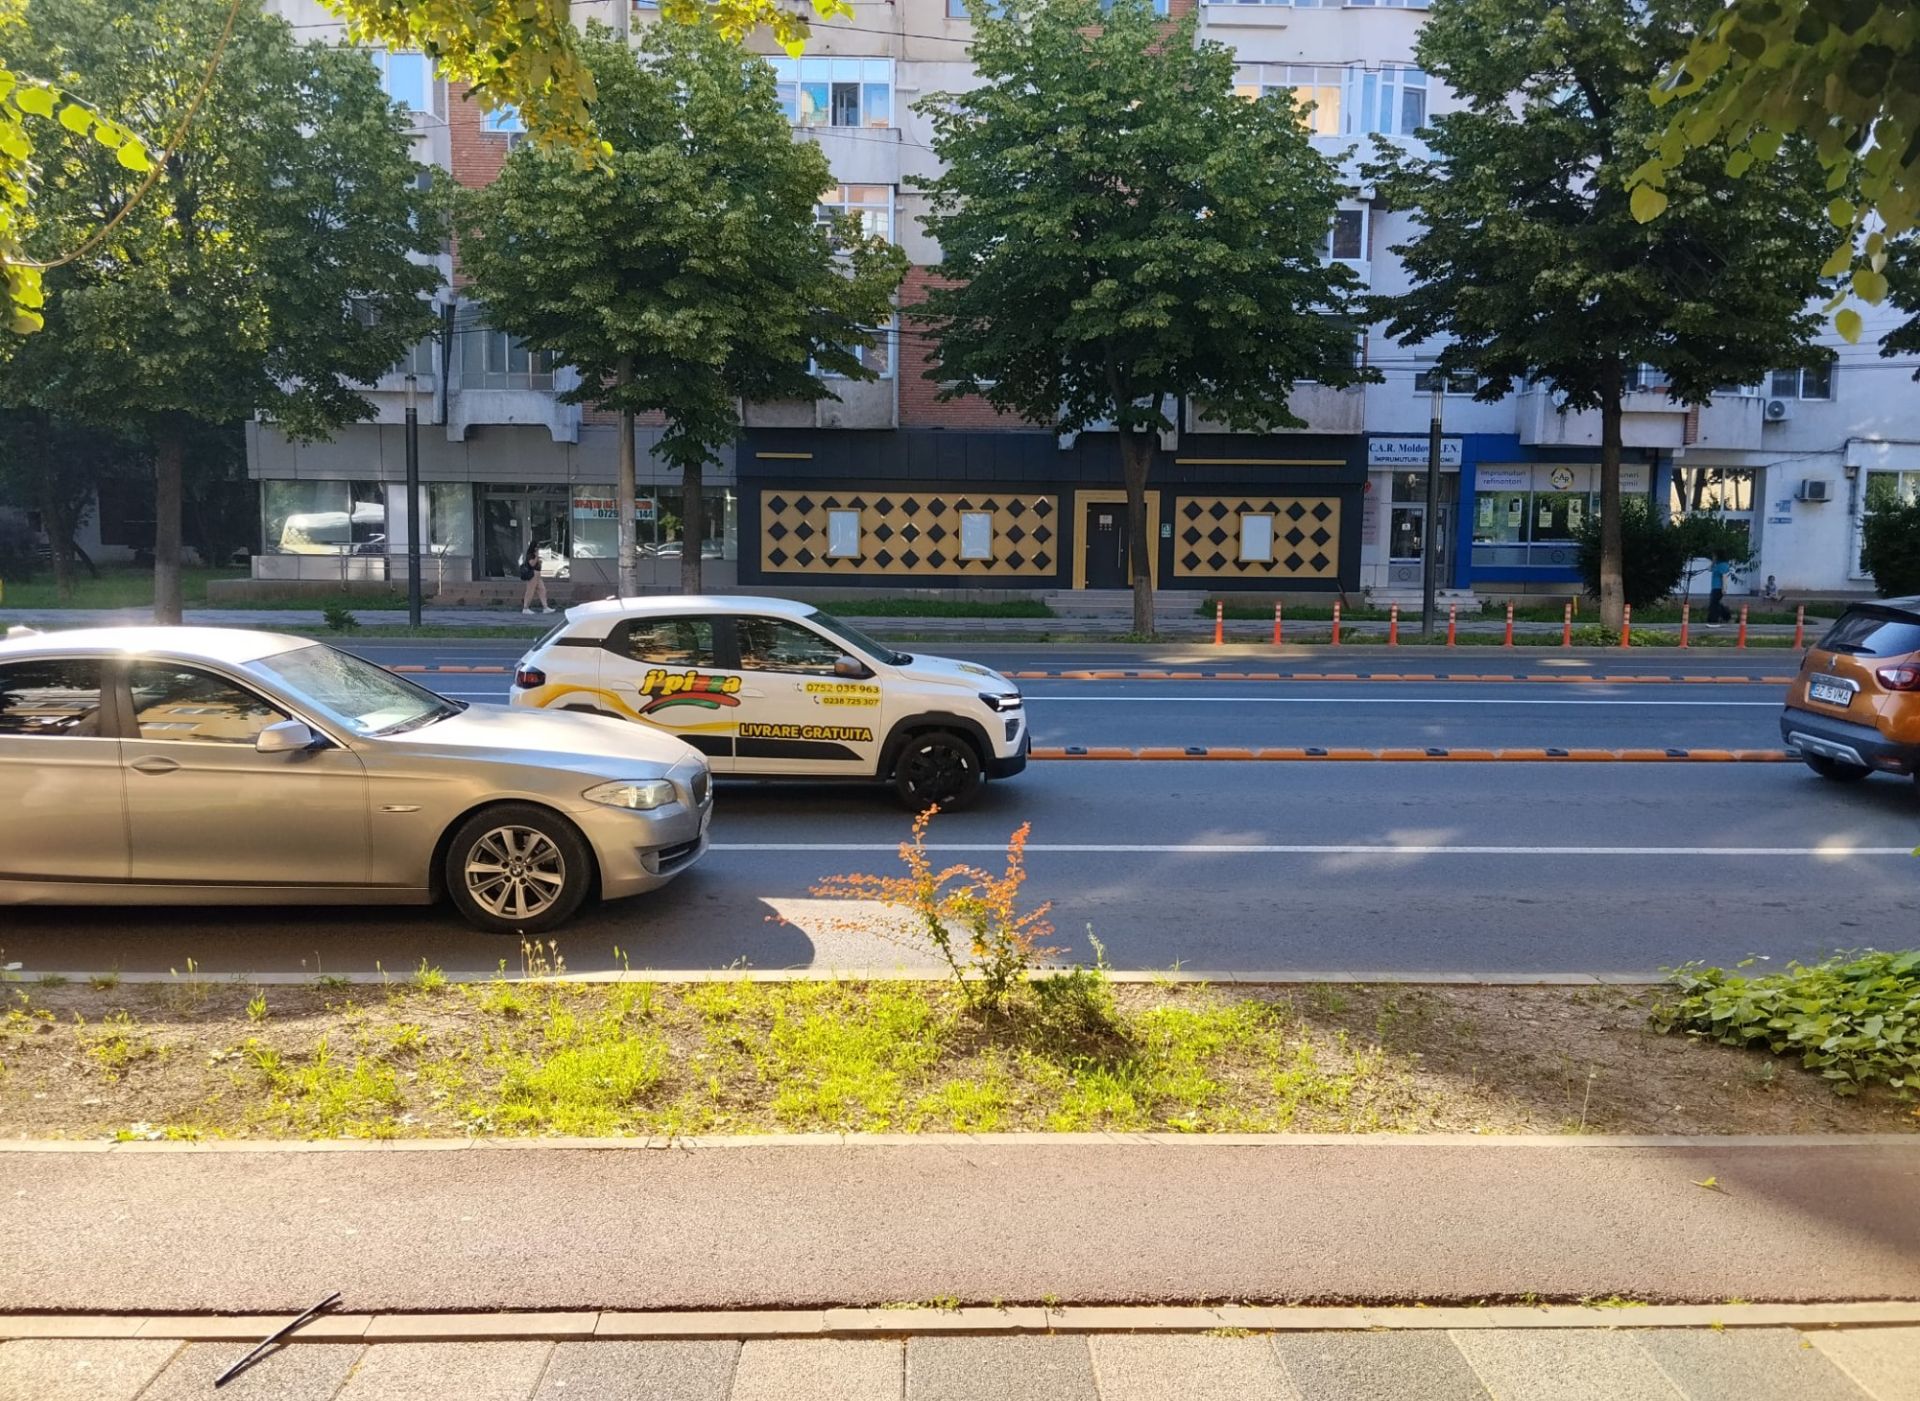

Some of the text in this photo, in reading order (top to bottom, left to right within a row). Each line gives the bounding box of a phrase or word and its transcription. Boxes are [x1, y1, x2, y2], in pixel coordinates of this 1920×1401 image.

[1369, 443, 1396, 453] C.A.R.
[806, 683, 879, 694] 0752 035 963
[740, 723, 872, 741] LIVRARE GRATUITA
